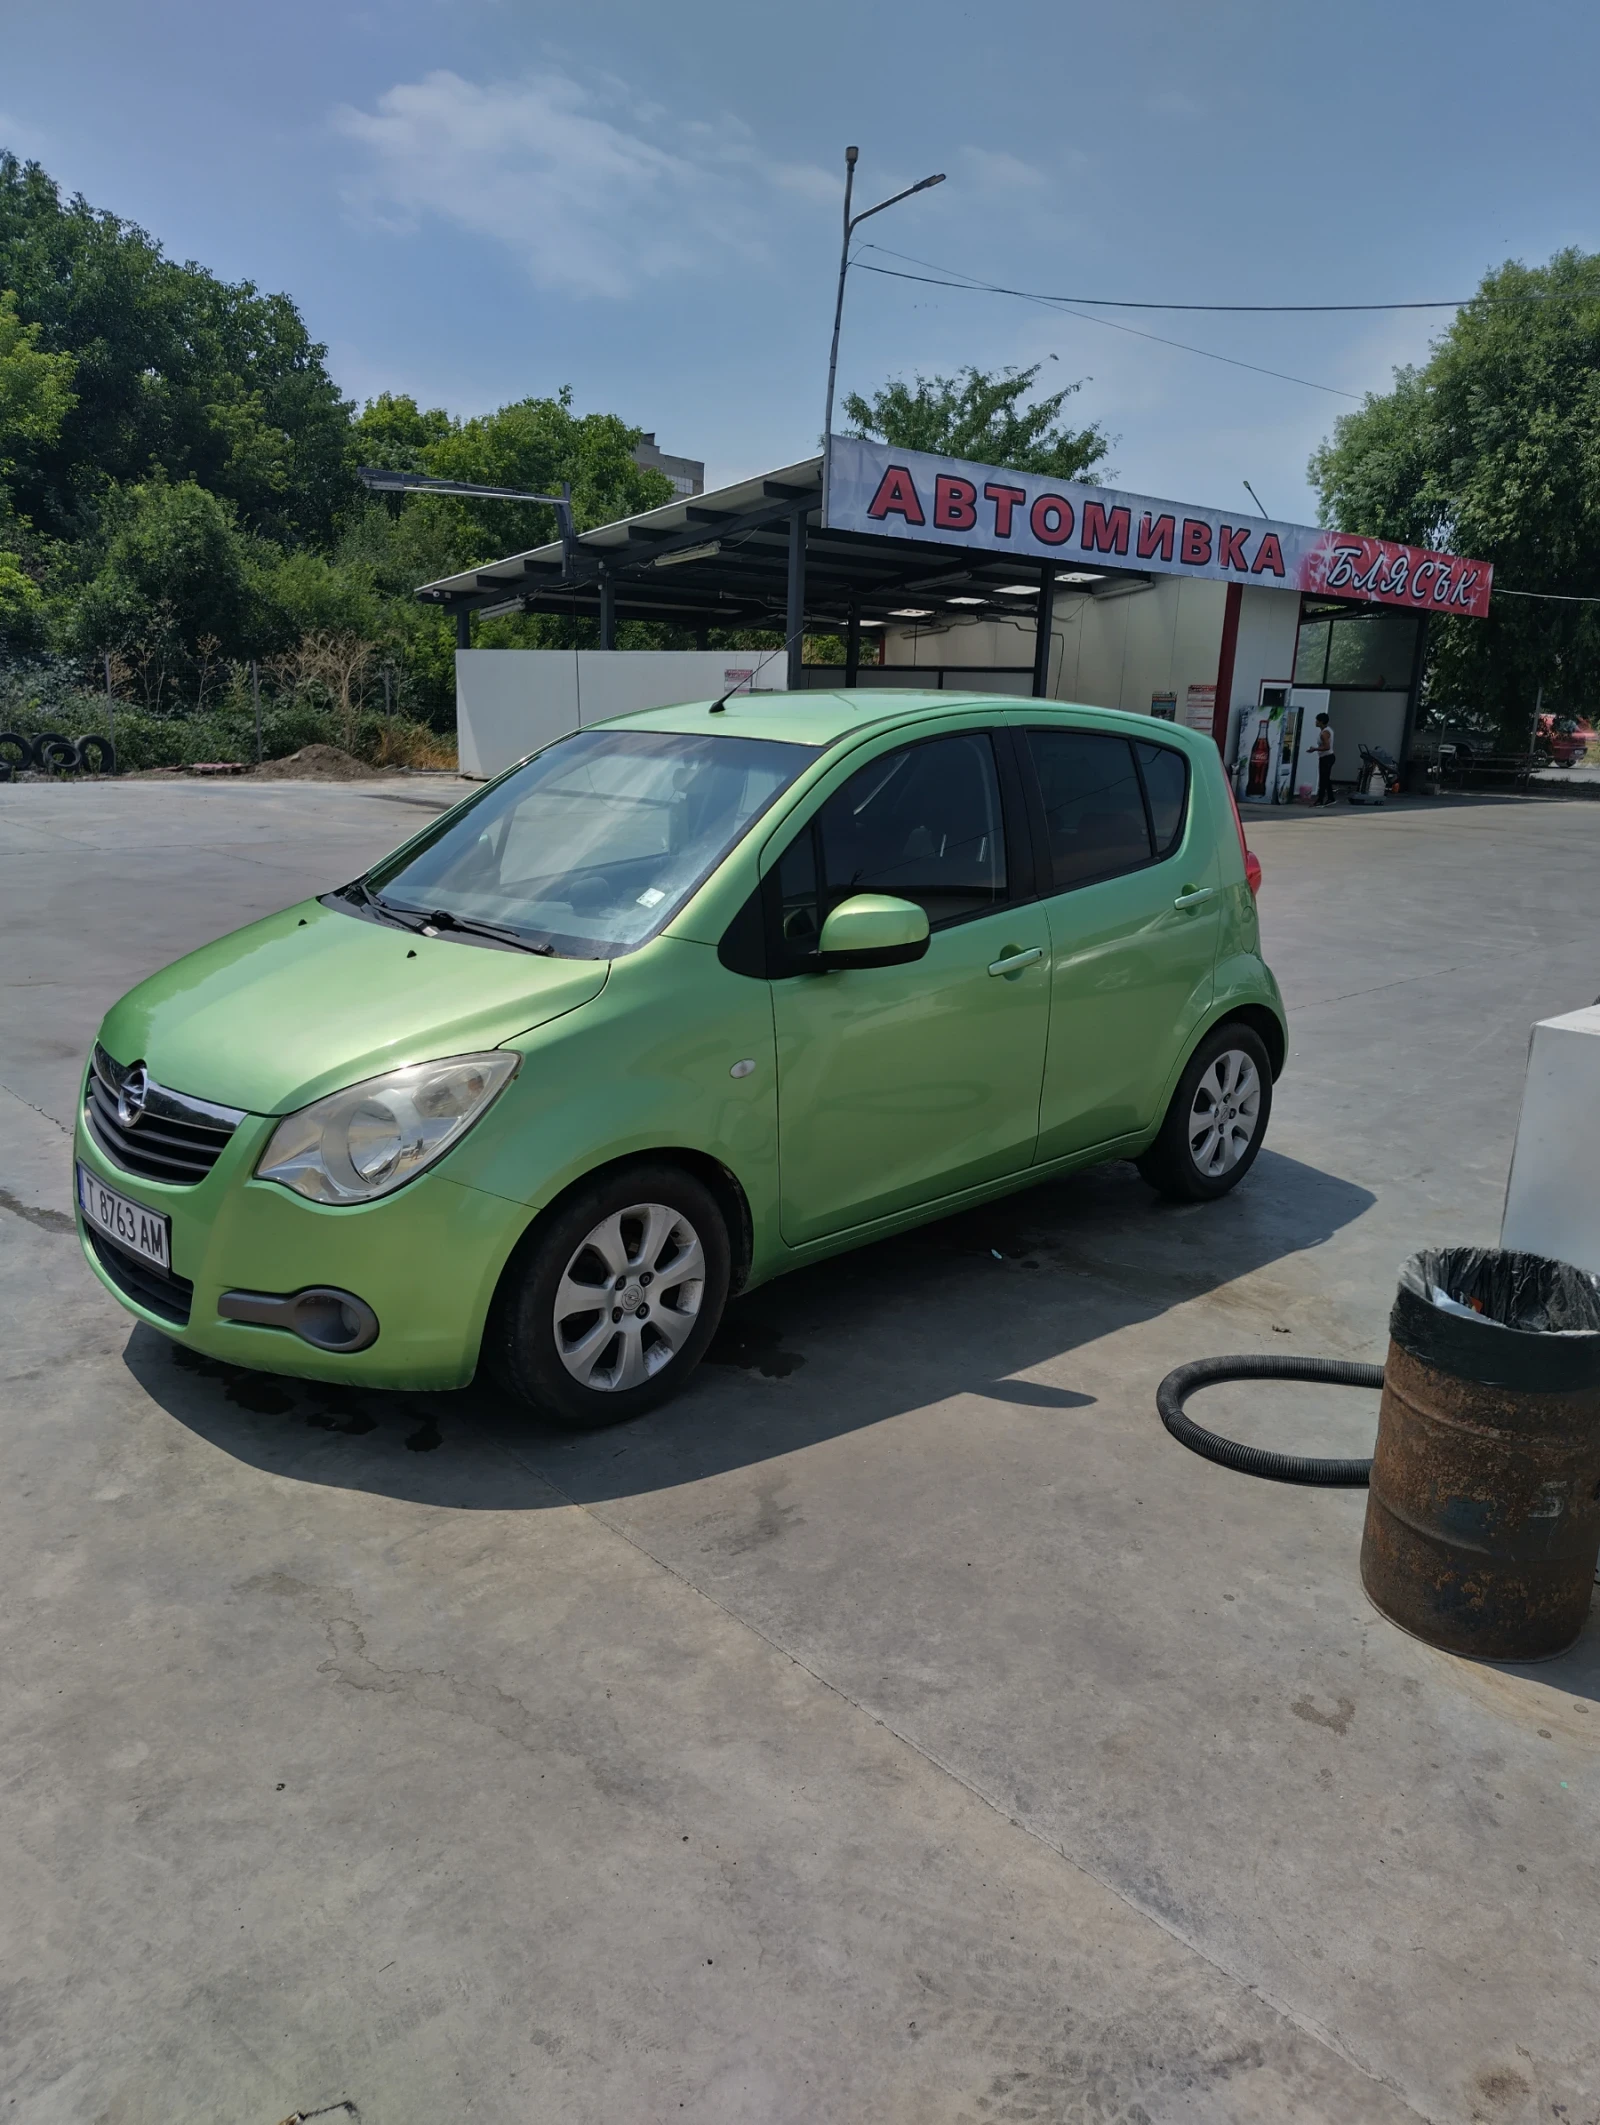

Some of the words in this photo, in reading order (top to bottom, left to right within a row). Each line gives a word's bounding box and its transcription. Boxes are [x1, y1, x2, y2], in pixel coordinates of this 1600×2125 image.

[867, 465, 1286, 577] АВТОМИВКА
[1327, 545, 1480, 607] БЛЯСЪК
[100, 1190, 136, 1242] 8763
